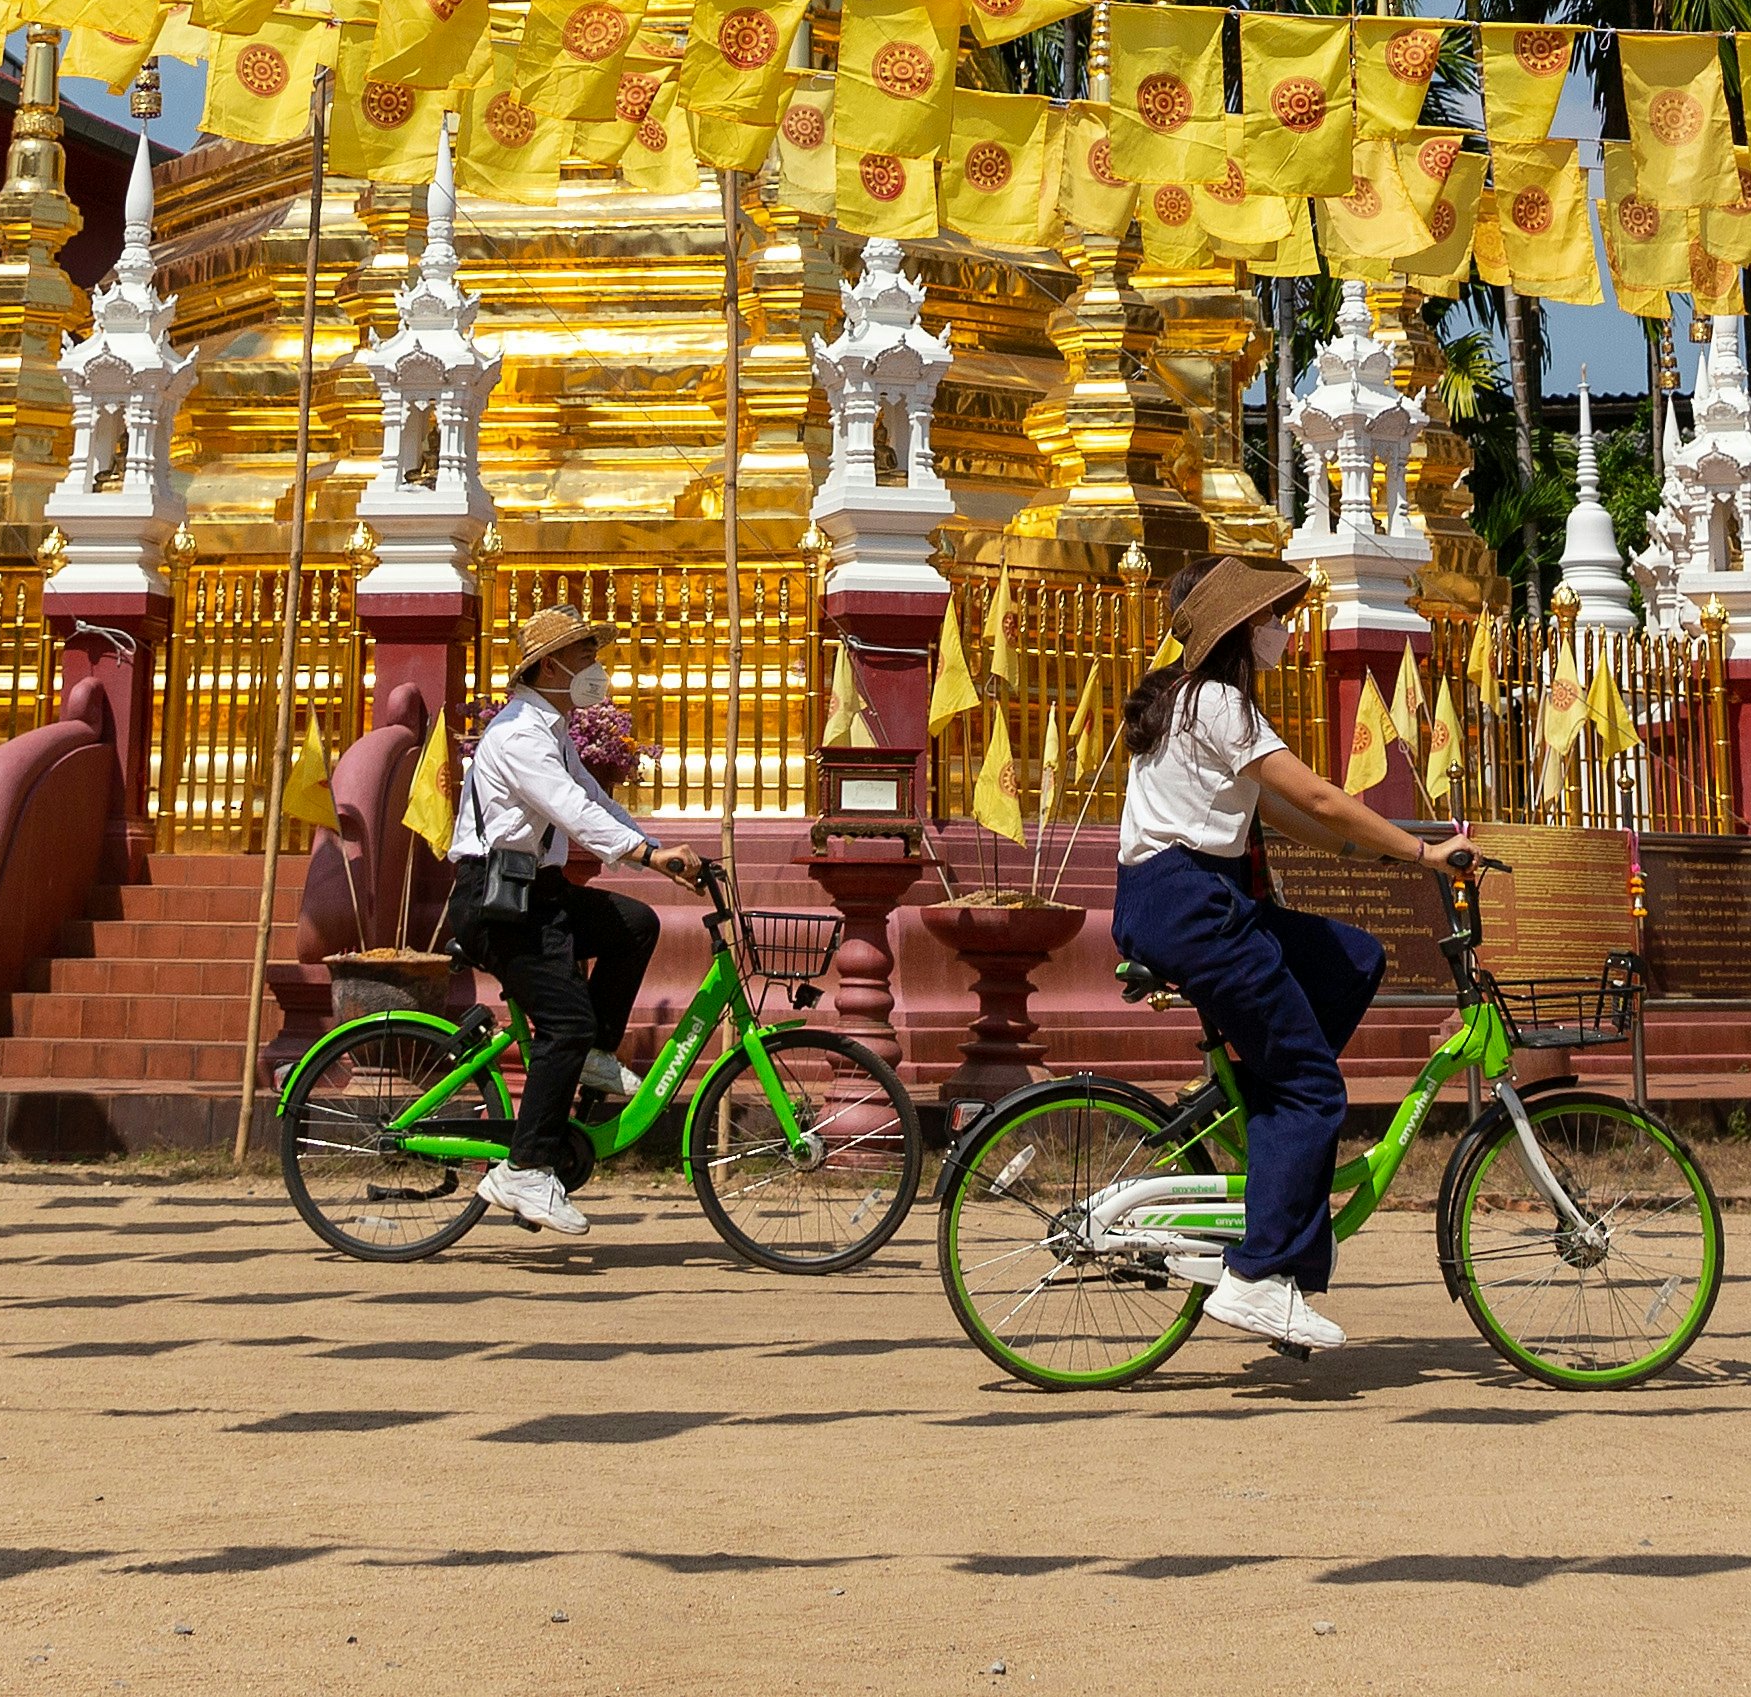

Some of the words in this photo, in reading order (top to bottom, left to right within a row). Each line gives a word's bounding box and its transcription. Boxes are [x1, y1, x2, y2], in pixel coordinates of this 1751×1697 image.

[655, 1015, 707, 1097] anywheel
[1398, 1075, 1438, 1146] anywheel
[1215, 1215, 1246, 1227] anyw
